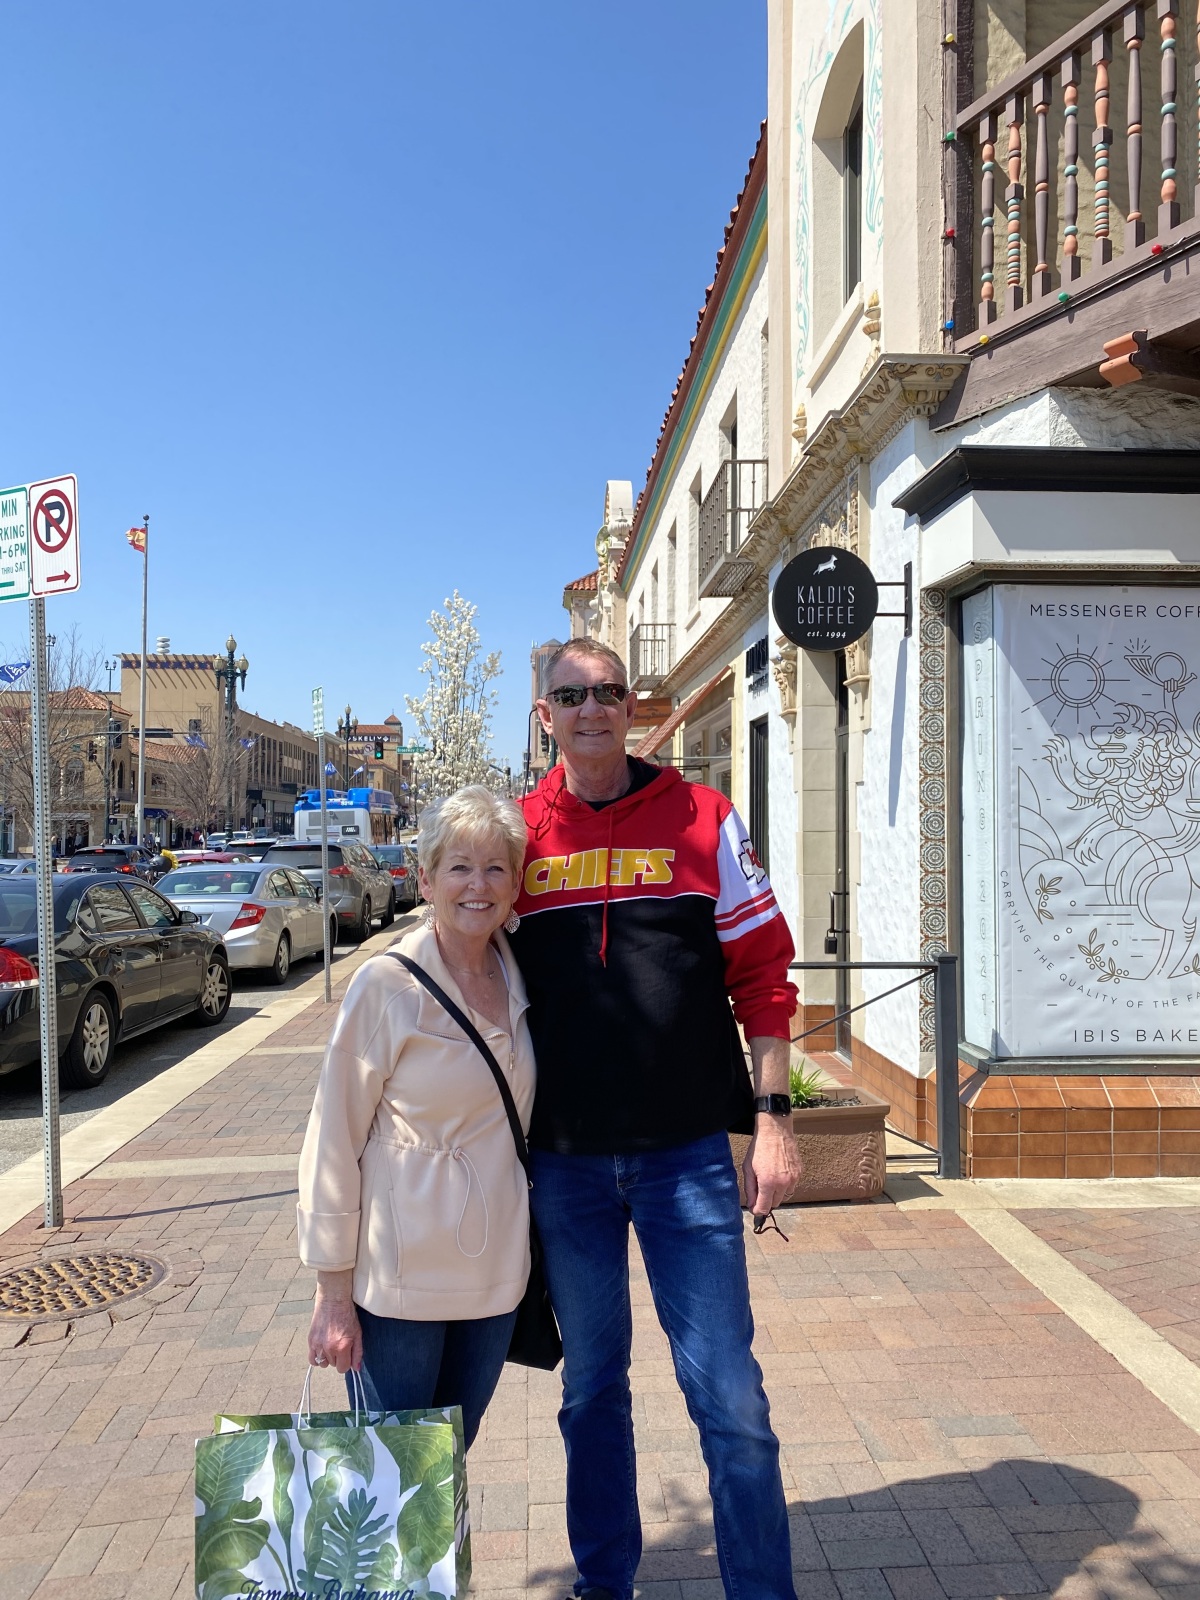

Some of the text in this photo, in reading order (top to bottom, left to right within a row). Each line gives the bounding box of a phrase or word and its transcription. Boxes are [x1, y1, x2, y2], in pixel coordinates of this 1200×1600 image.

[1, 498, 17, 518] MIN
[1, 560, 26, 575] THRU SAT
[797, 585, 855, 604] KALDI'S
[797, 606, 855, 625] COFFEE
[1030, 603, 1200, 618] MESSENGER COF
[826, 631, 847, 639] 1994
[973, 621, 987, 1016] SPRING 2021
[523, 847, 676, 897] CHIEFS
[1000, 870, 1032, 943] CARRYING
[1033, 947, 1055, 971] THE
[1059, 973, 1118, 1005] QUALITY
[1126, 1000, 1143, 1009] OF
[1153, 998, 1179, 1008] THE
[1074, 1029, 1198, 1043] IBIS BAKE
[236, 1579, 417, 1600] Tommy Bahama
